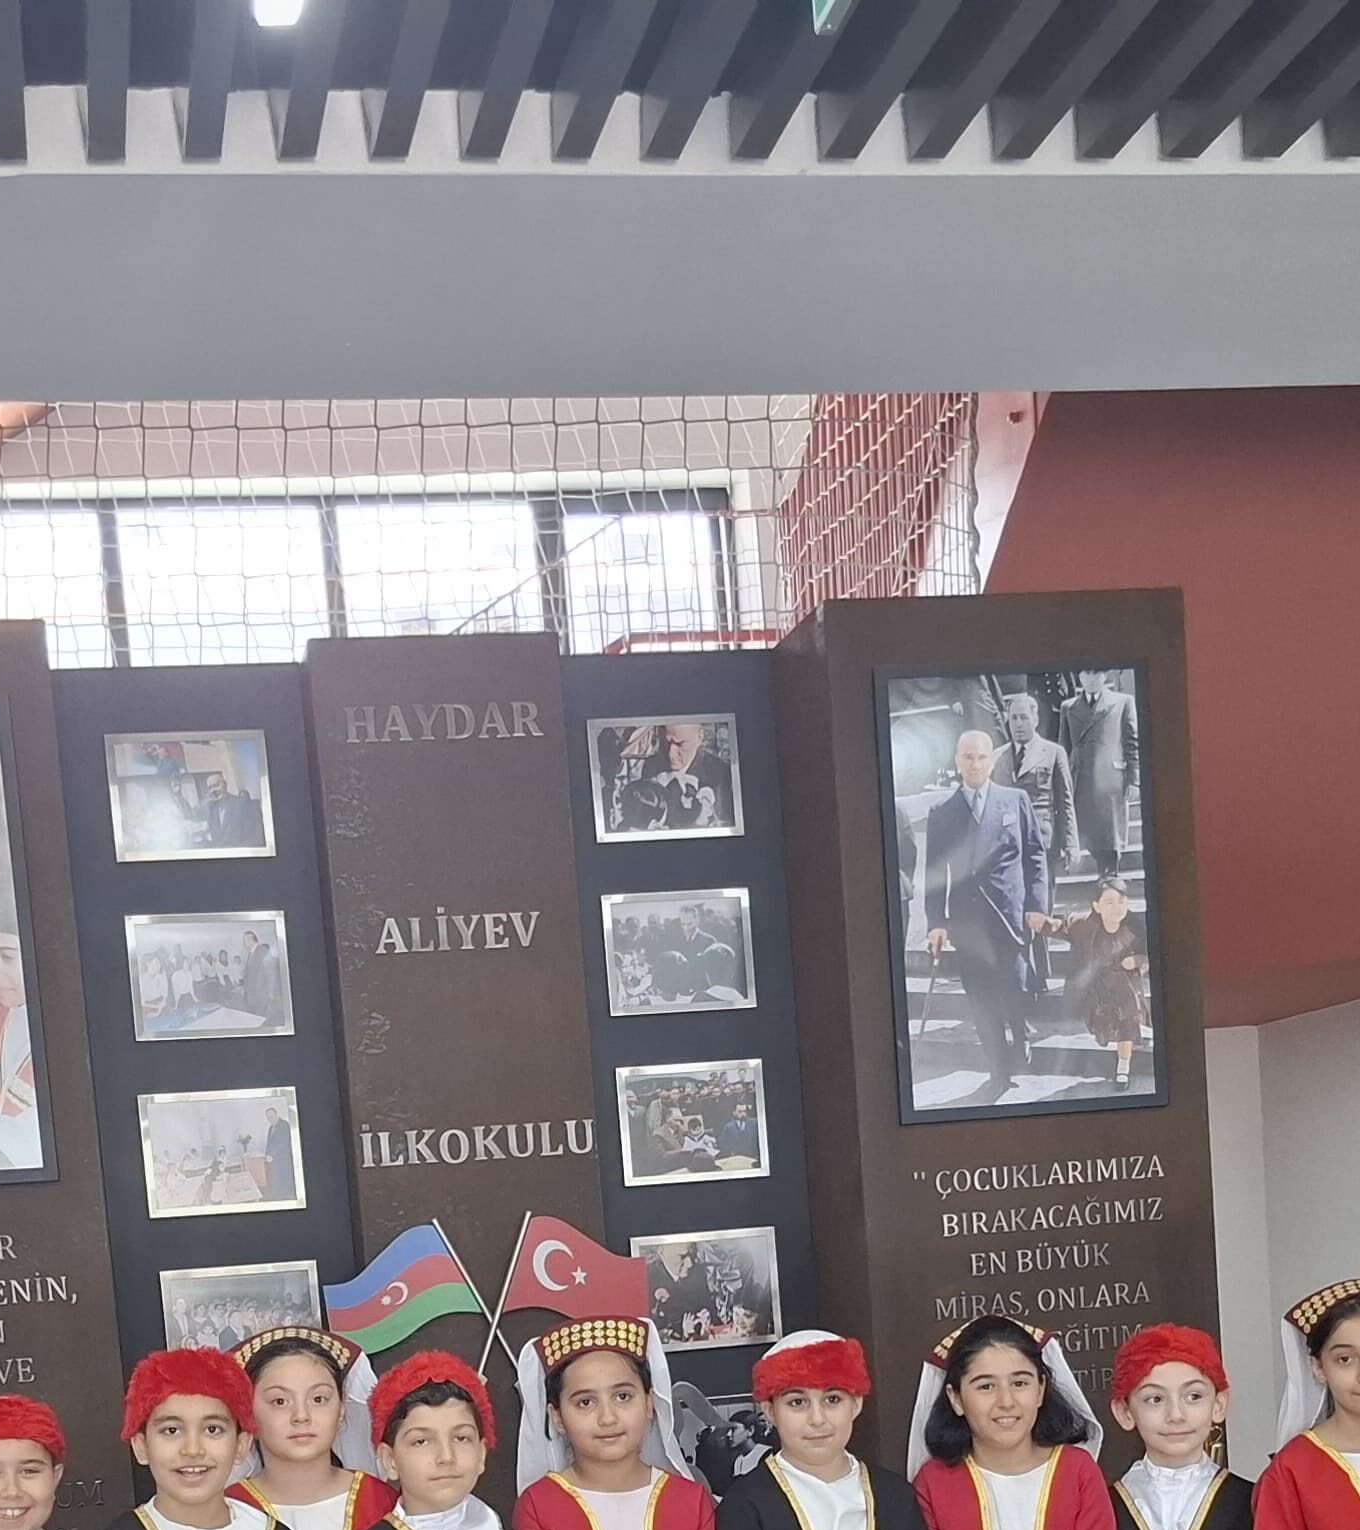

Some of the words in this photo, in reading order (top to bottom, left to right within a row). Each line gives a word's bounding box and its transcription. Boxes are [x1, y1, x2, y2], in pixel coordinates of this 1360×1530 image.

[343, 700, 546, 745] HAYDAR
[374, 906, 541, 955] ALİYEV
[360, 1117, 596, 1169] İLKOKULU
[934, 1154, 1166, 1201] ÇOCUKLARIMIZA
[941, 1196, 1165, 1239] BIRAKACAĞIMIZ
[969, 1249, 1008, 1278] EN
[1016, 1240, 1112, 1274] BÜYÜK
[934, 1289, 1031, 1322] MİRAS,
[1037, 1280, 1152, 1313] ONLARA
